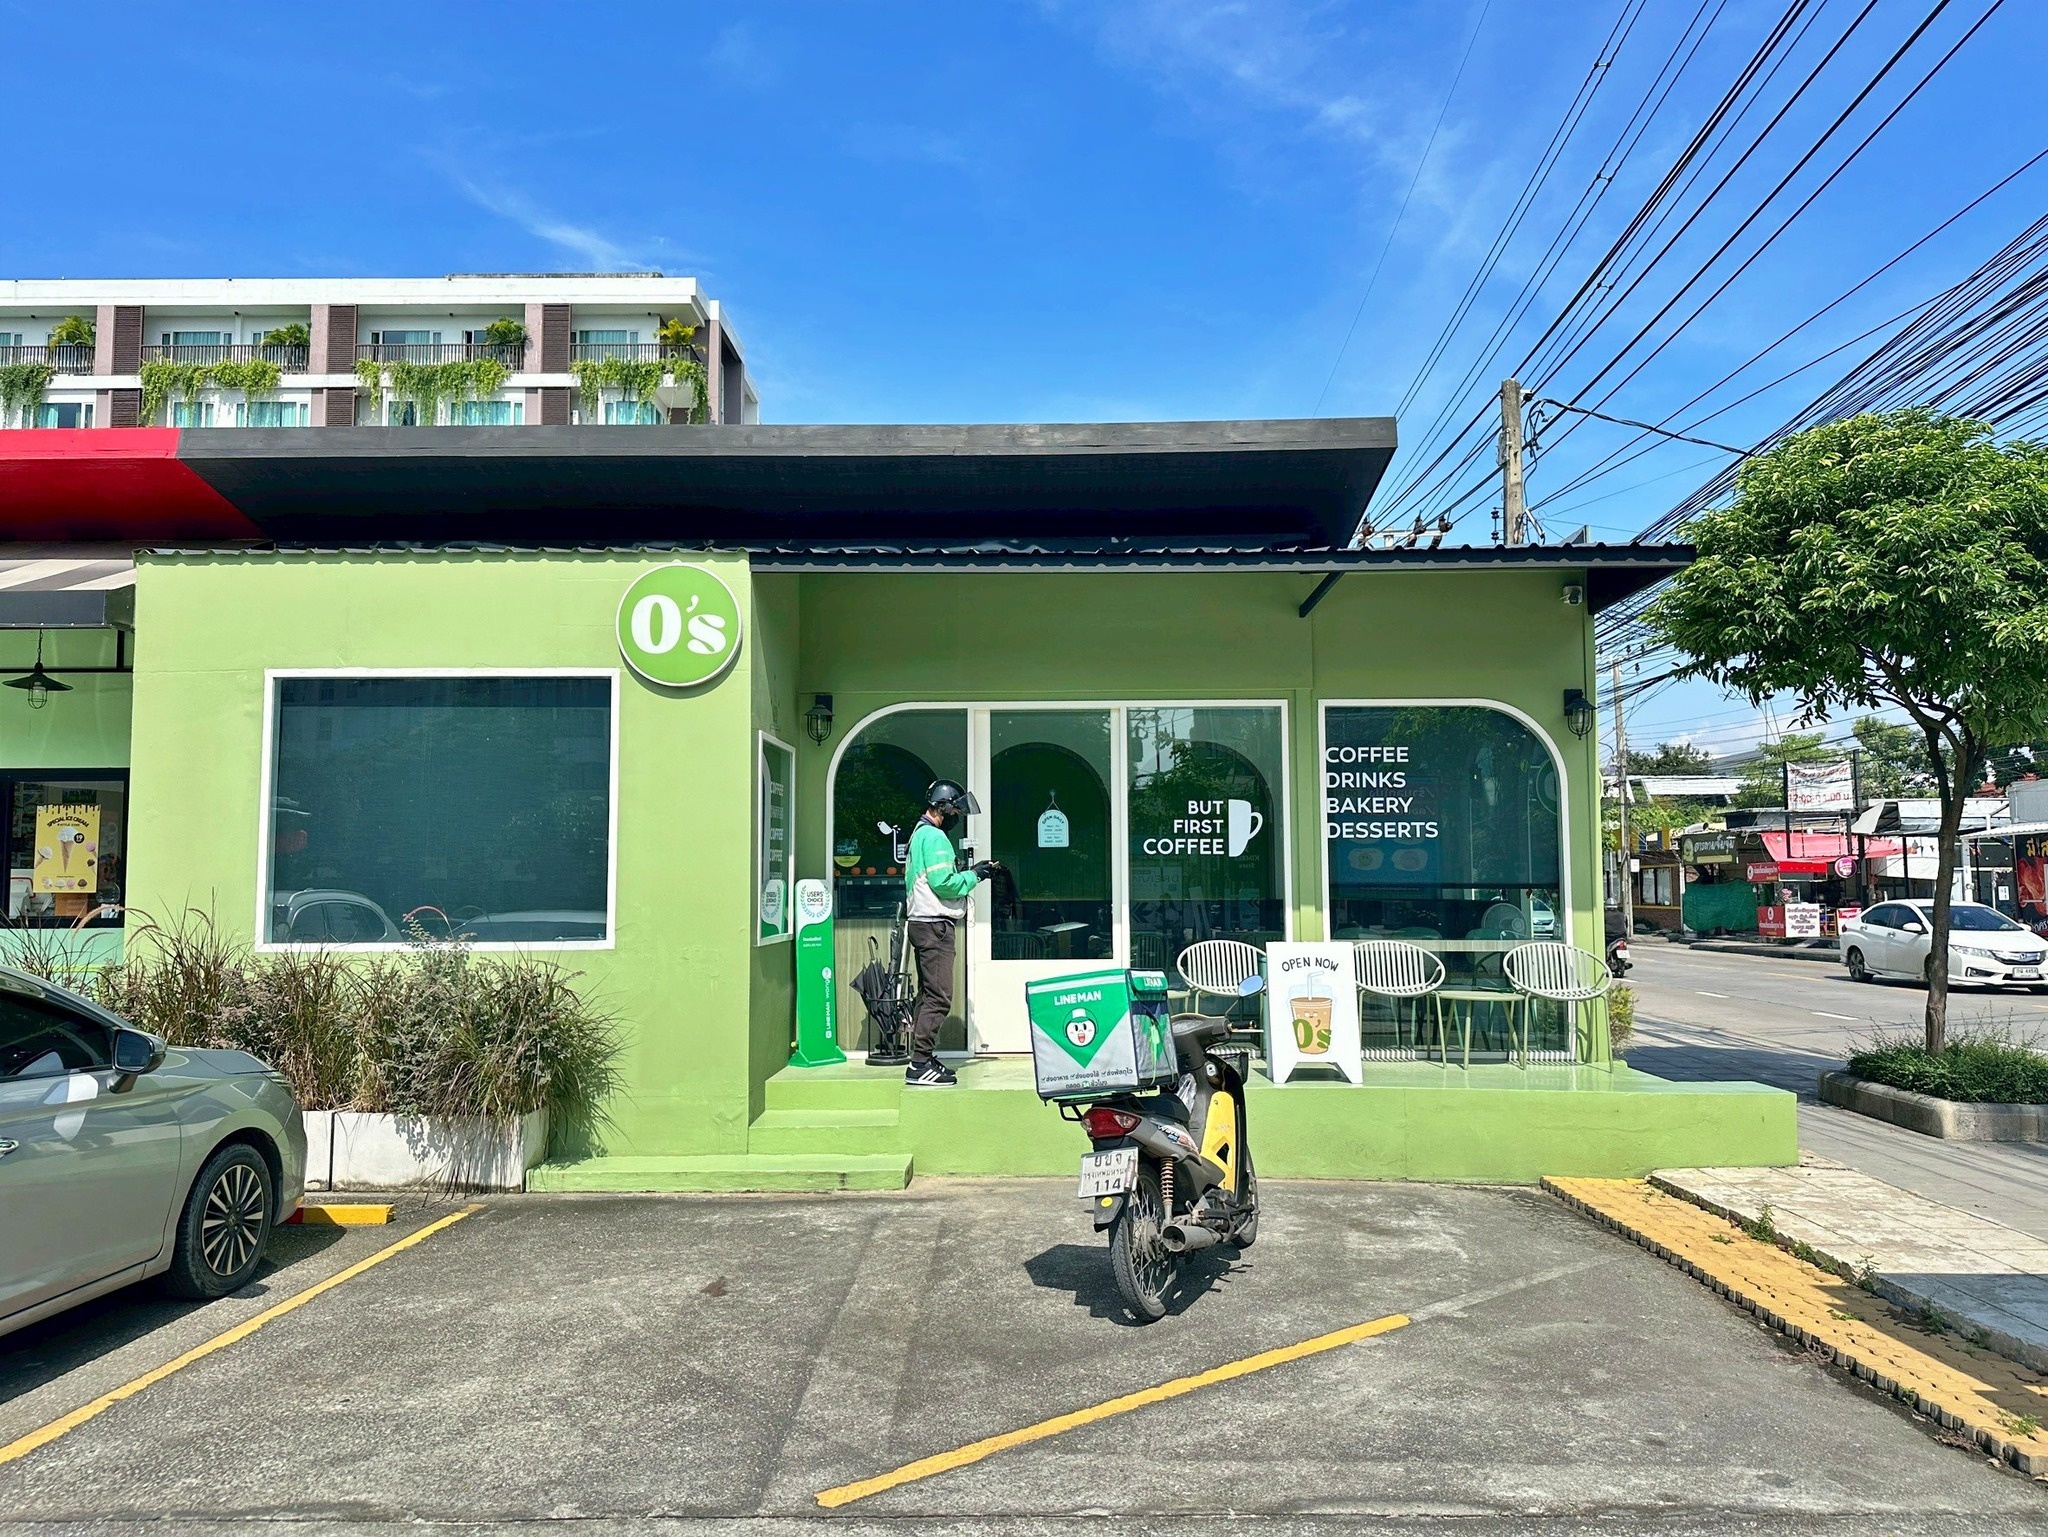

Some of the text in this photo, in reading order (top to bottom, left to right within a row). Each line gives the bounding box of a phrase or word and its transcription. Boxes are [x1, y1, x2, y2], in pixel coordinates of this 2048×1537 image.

[631, 594, 727, 655] O's
[1326, 746, 1409, 763] COFFEE
[1326, 771, 1406, 788] DRINKS
[1188, 800, 1224, 815] BUT
[1327, 797, 1414, 813] BAKERY
[1173, 819, 1224, 834] FIRST
[1327, 822, 1439, 838] DESSERTS
[1143, 838, 1225, 855] COFFEE
[1281, 957, 1339, 972] OPEN NOW
[1094, 1177, 1121, 1193] 114
